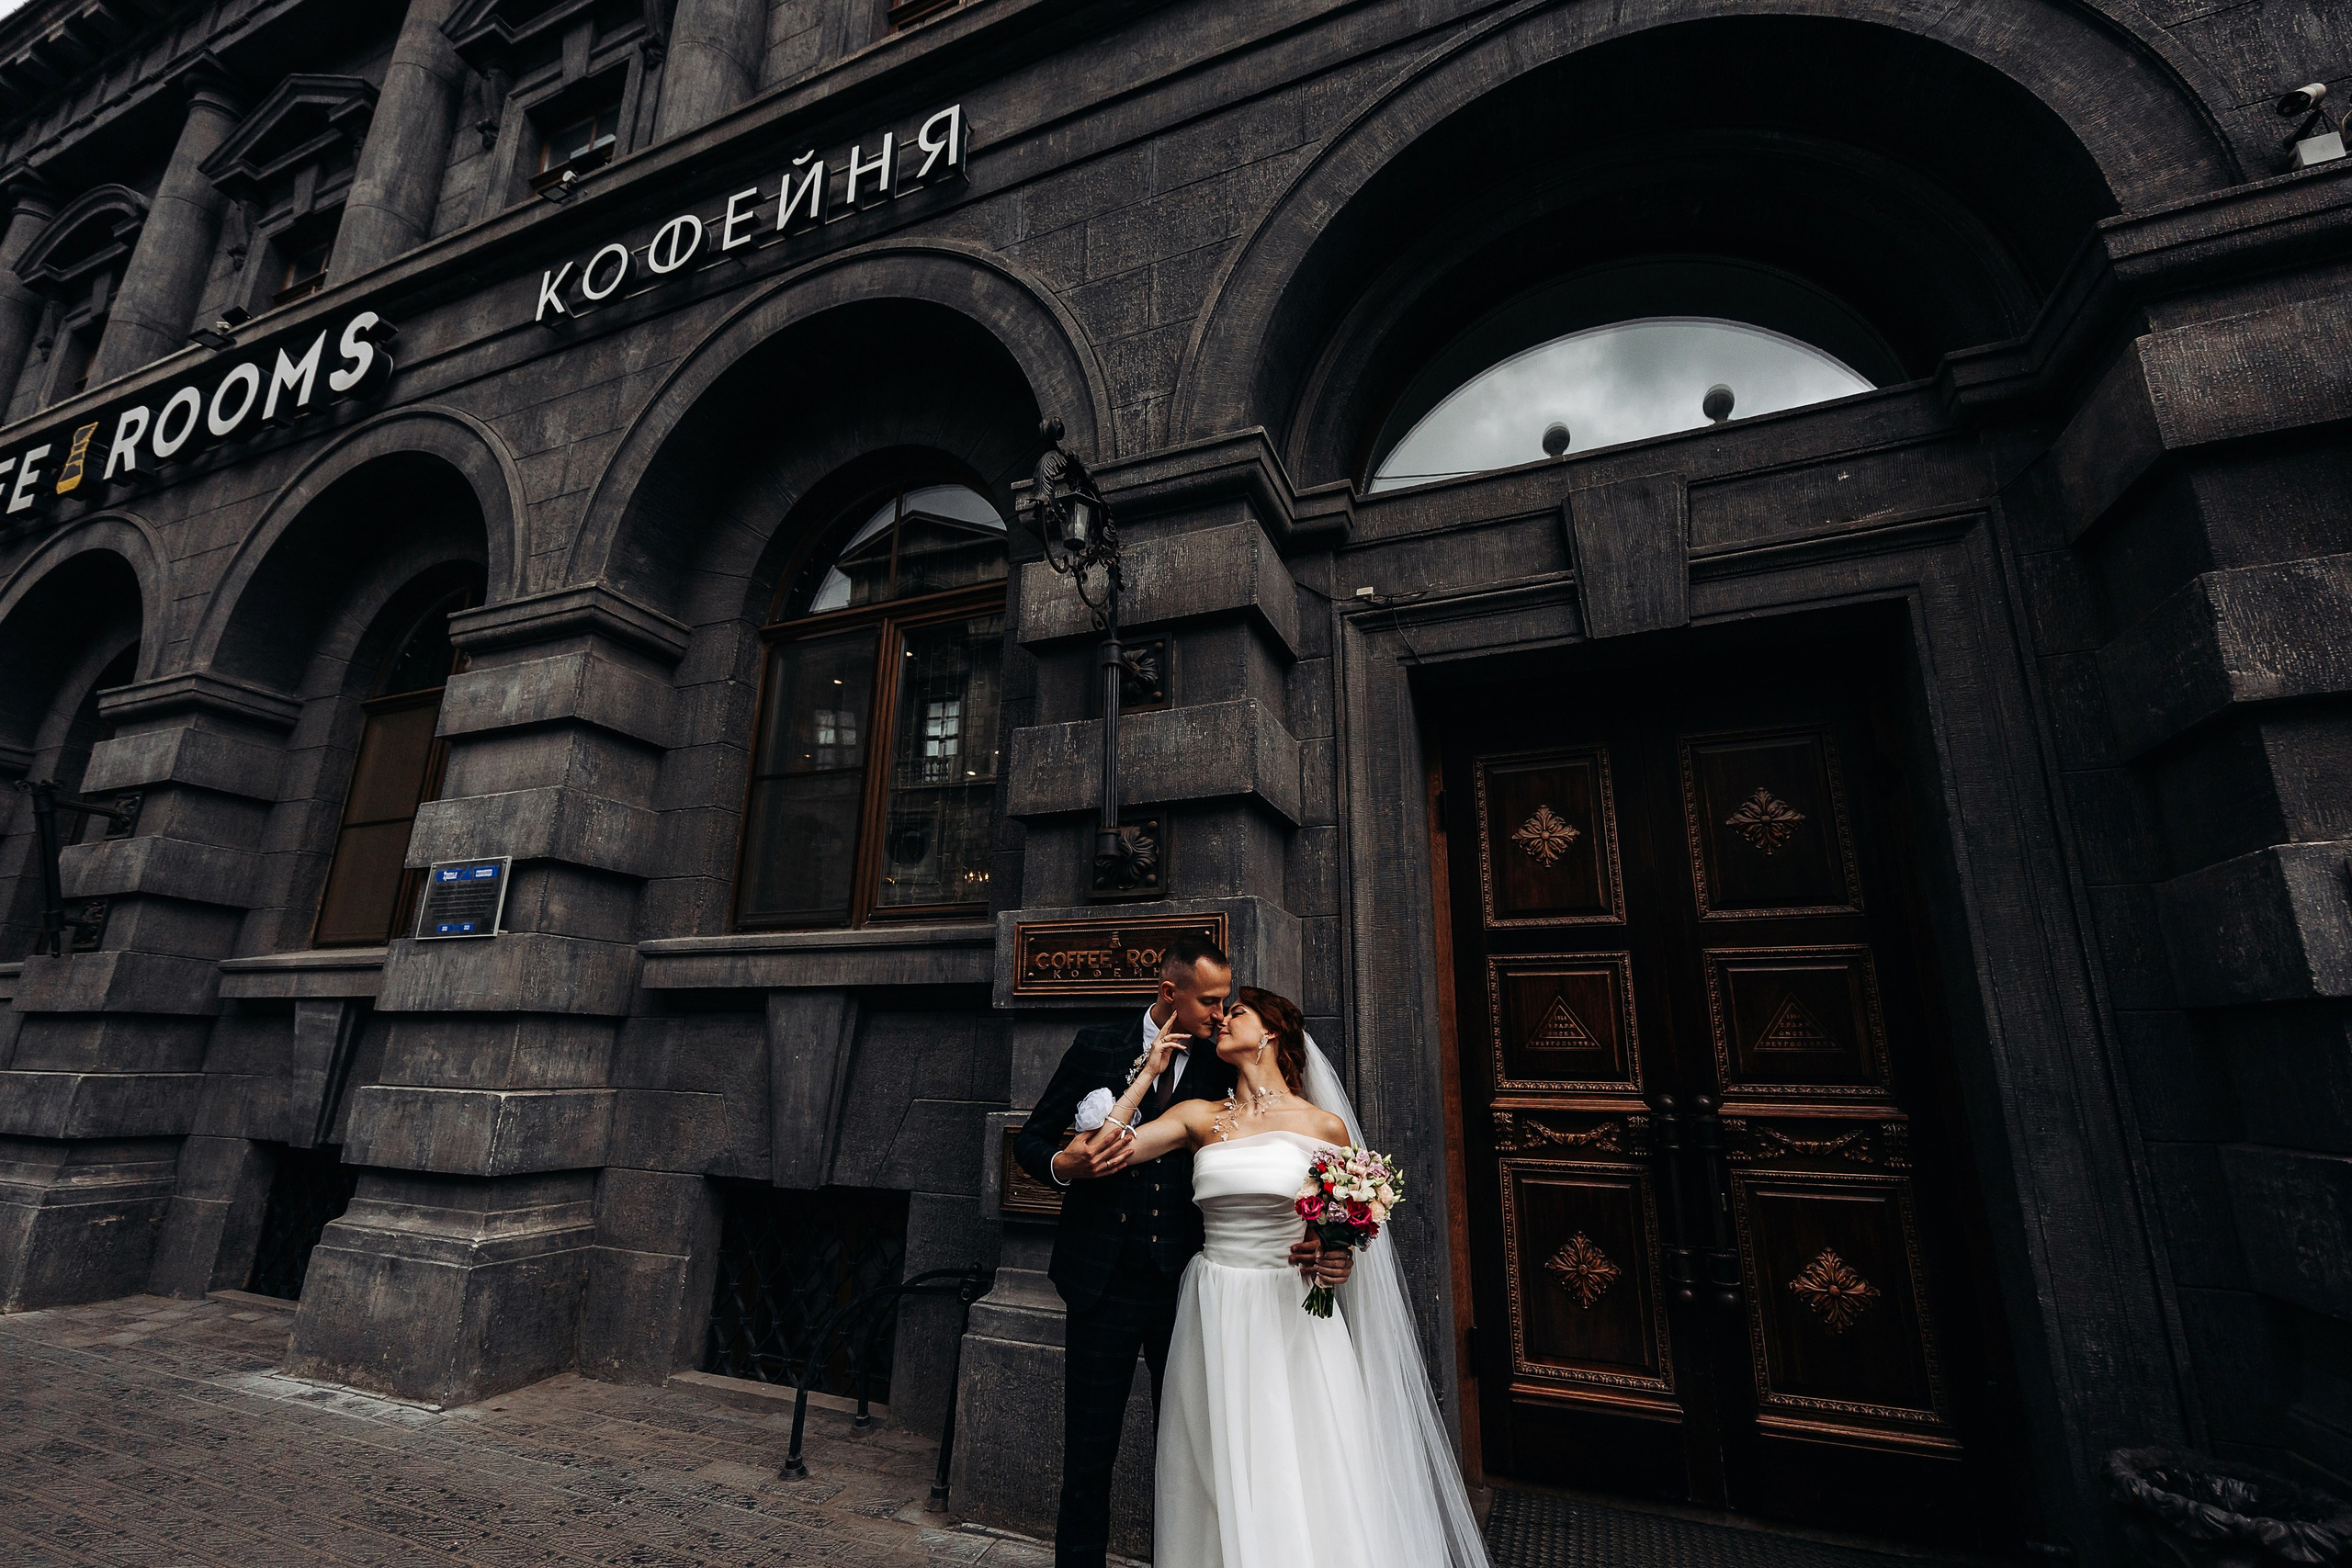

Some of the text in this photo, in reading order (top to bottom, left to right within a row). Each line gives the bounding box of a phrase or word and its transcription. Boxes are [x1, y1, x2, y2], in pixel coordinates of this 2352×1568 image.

[536, 104, 960, 321] КОФЕЙНЯ
[103, 311, 379, 480] ROOMS
[1035, 950, 1113, 970] COFFEE
